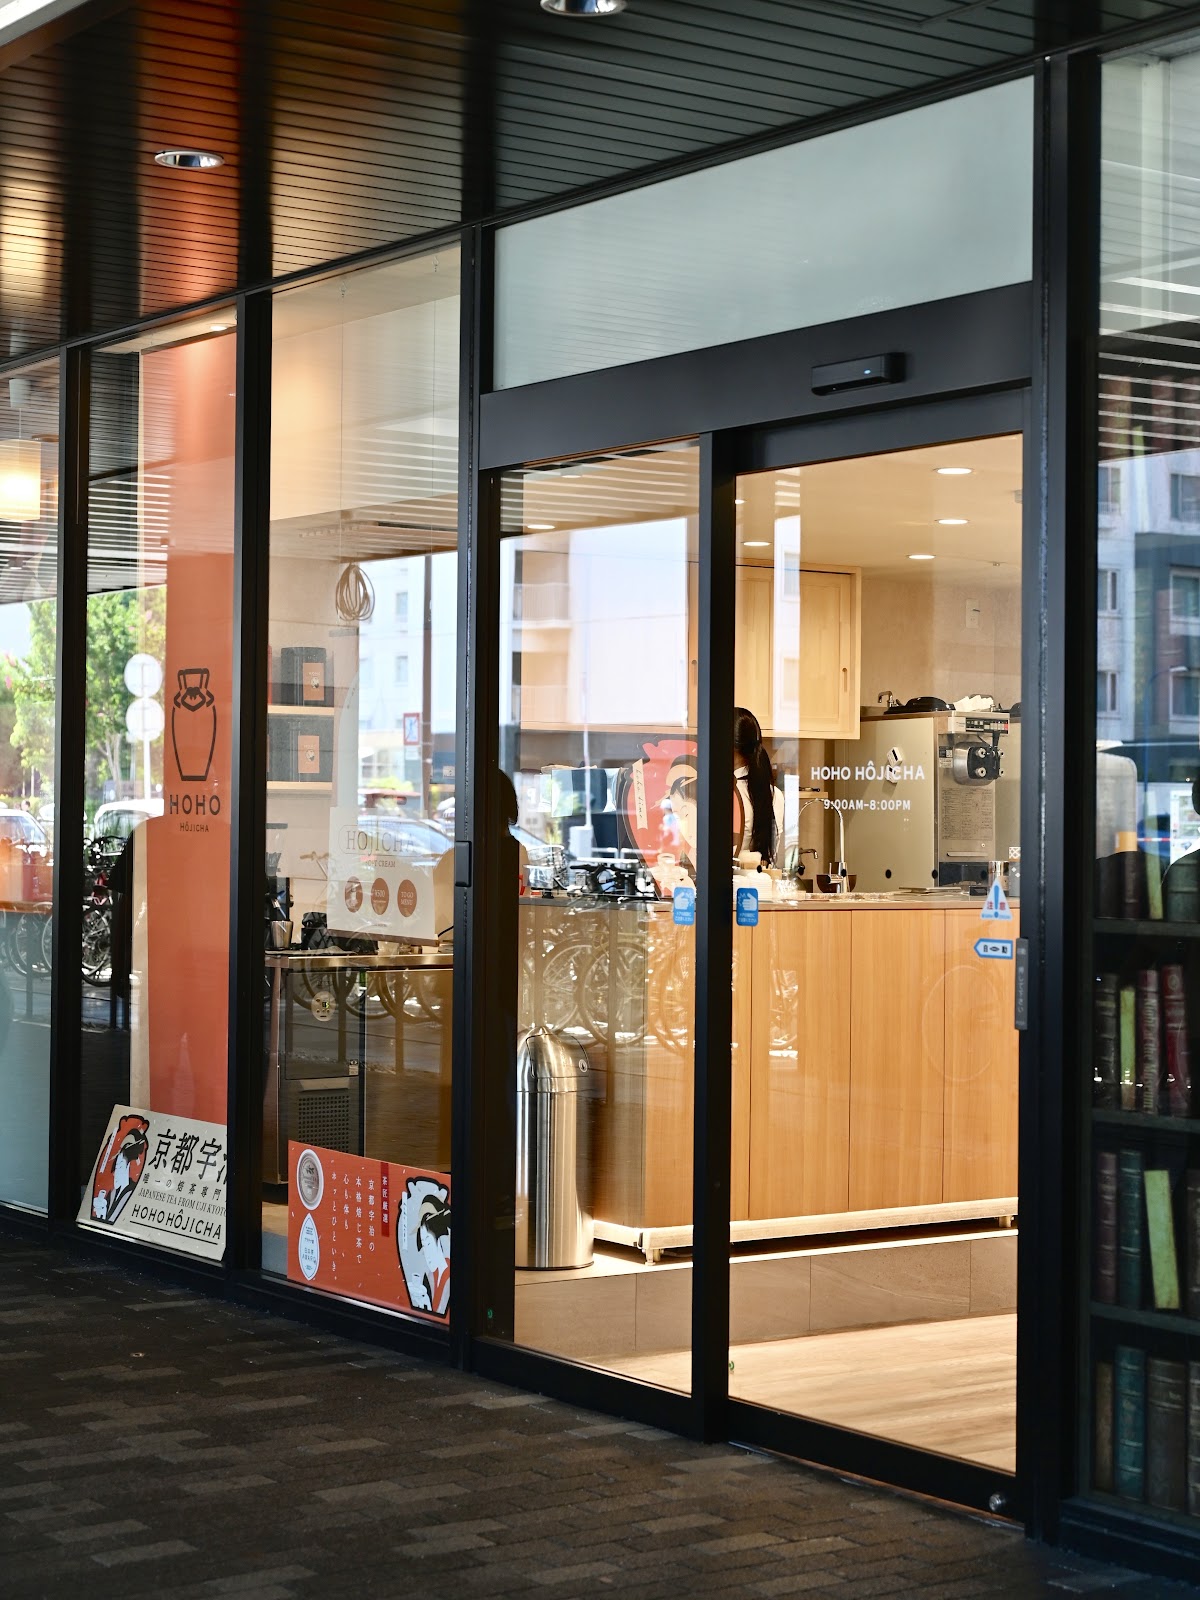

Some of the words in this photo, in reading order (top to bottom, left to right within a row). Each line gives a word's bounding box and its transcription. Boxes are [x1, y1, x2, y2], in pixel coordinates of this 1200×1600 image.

[811, 766, 851, 780] HOHO
[169, 794, 221, 815] HOHO
[823, 799, 911, 810] 9:00AM-8:00PM
[377, 860, 396, 868] CREAM
[138, 1187, 166, 1202] JAPANESE
[166, 1194, 177, 1204] TEA
[177, 1197, 196, 1209] FROM
[195, 1201, 207, 1212] UJI
